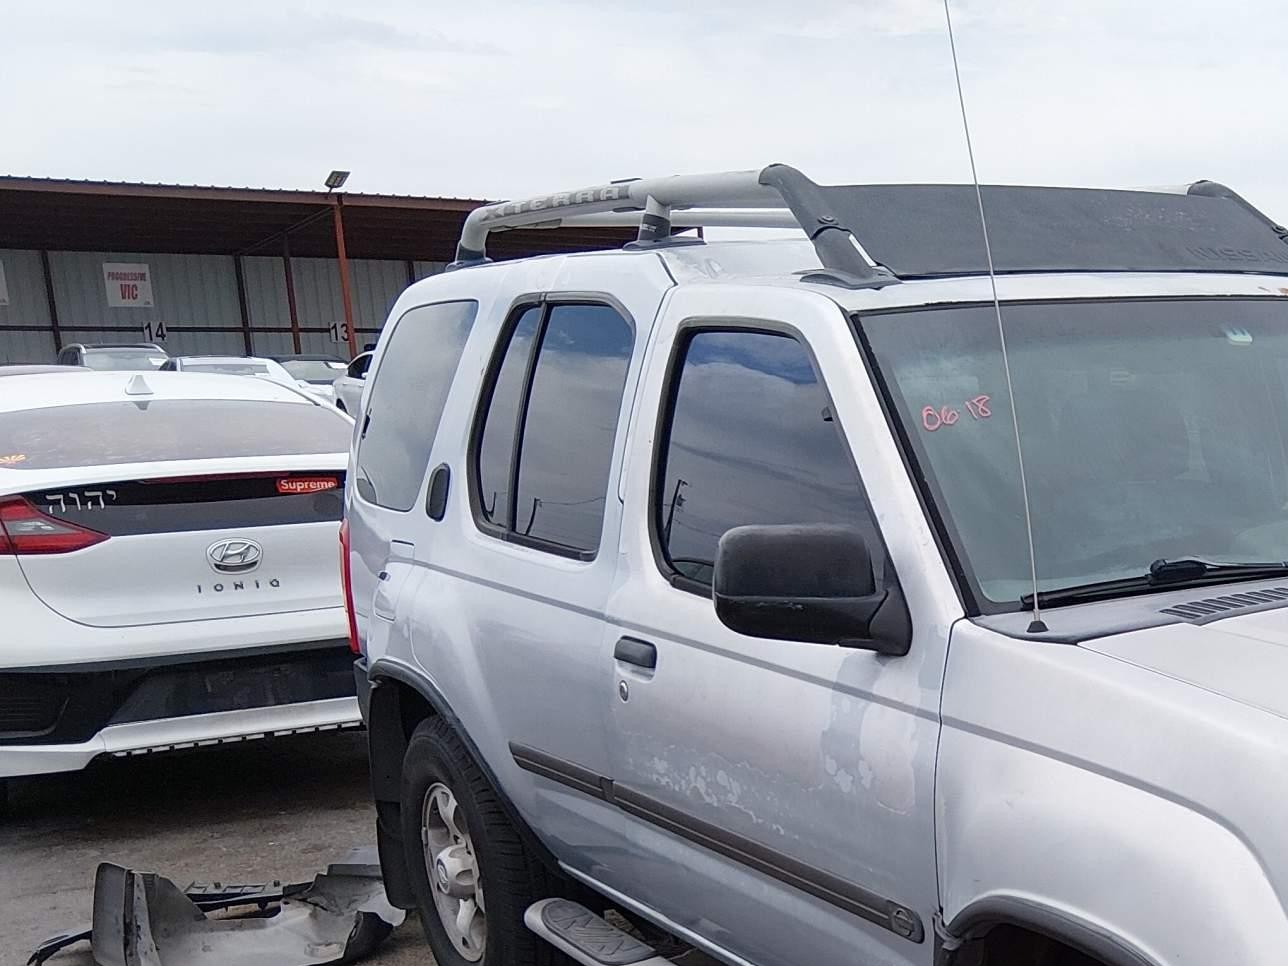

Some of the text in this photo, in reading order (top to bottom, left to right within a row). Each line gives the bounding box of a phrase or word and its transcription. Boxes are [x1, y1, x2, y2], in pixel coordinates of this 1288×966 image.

[107, 271, 147, 282] PROGRESSIVE
[120, 283, 138, 300] VIC
[144, 321, 167, 341] 14
[331, 322, 349, 341] 13
[280, 479, 337, 492] Supreme
[45, 489, 117, 514] יהוה
[197, 578, 281, 594] IONIQ
